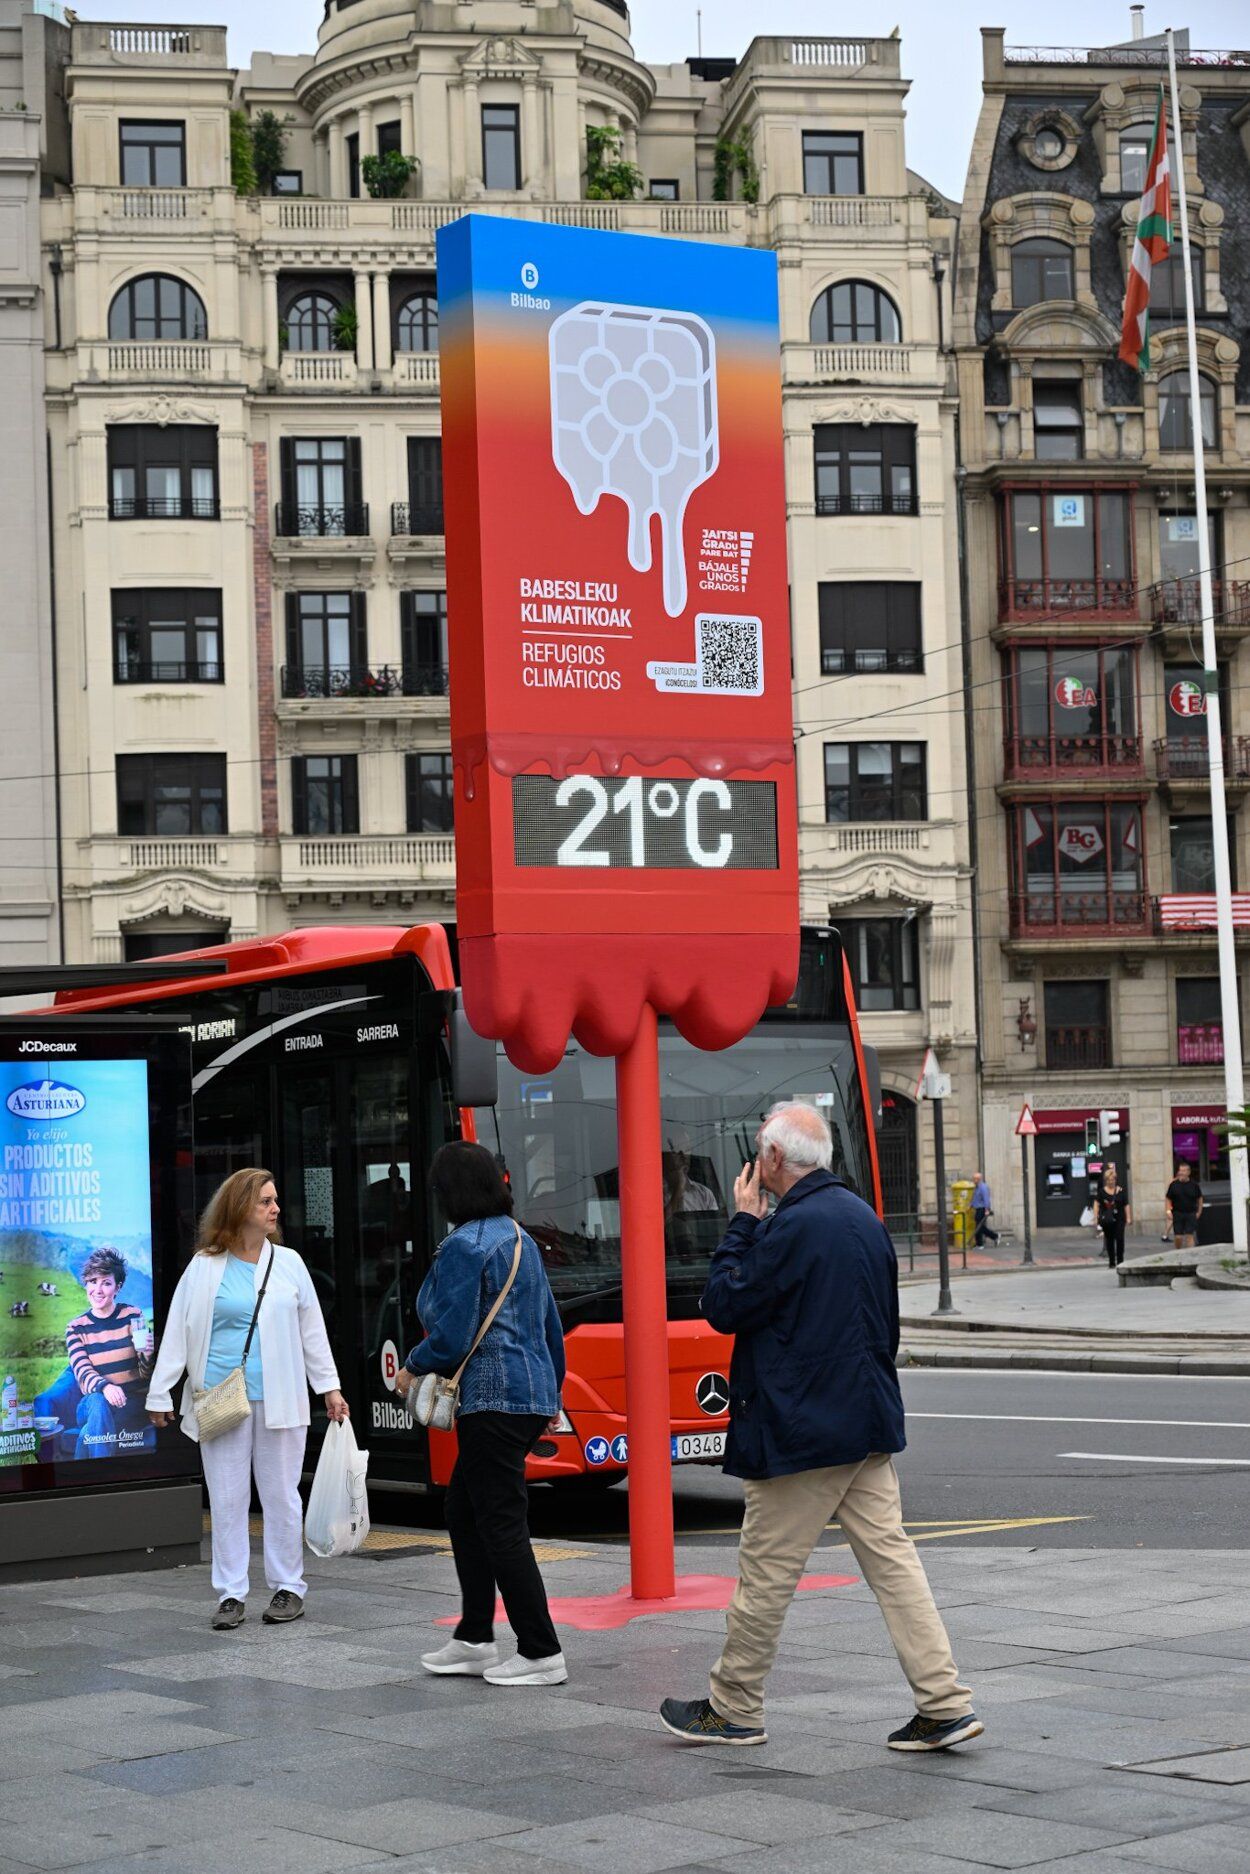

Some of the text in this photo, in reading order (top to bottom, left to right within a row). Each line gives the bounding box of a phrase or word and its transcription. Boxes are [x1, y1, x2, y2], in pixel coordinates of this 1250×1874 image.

[511, 292, 551, 311] Bilbao
[702, 529, 738, 541] JAITSI
[700, 548, 721, 557] PARE
[702, 539, 739, 550] GRADU
[698, 560, 739, 574] BÁJALE
[698, 580, 740, 592] GRADOS
[707, 571, 739, 583] UNOS
[520, 578, 618, 602] BABESLEKU
[521, 603, 632, 628] KLIMATIKOAK
[522, 642, 605, 665] REFUGIOS
[523, 665, 621, 690] CLIMÁTICOS
[357, 1024, 399, 1042] SARRERA
[18, 1041, 77, 1052] JCDecaux
[285, 1034, 323, 1052] ENTRADA
[1176, 1116, 1209, 1124] LABORAL
[26, 1128, 68, 1142] Yo elijo
[4, 1142, 93, 1170] PRODUCTOS
[0, 1170, 101, 1199] SIN ADITIVOS
[0, 1198, 101, 1227] ARTIFICIALES
[385, 1353, 396, 1378] B
[372, 1402, 414, 1430] Bilbao
[84, 1428, 144, 1443] Sonsoles Ónega
[681, 1435, 722, 1456] 0348
